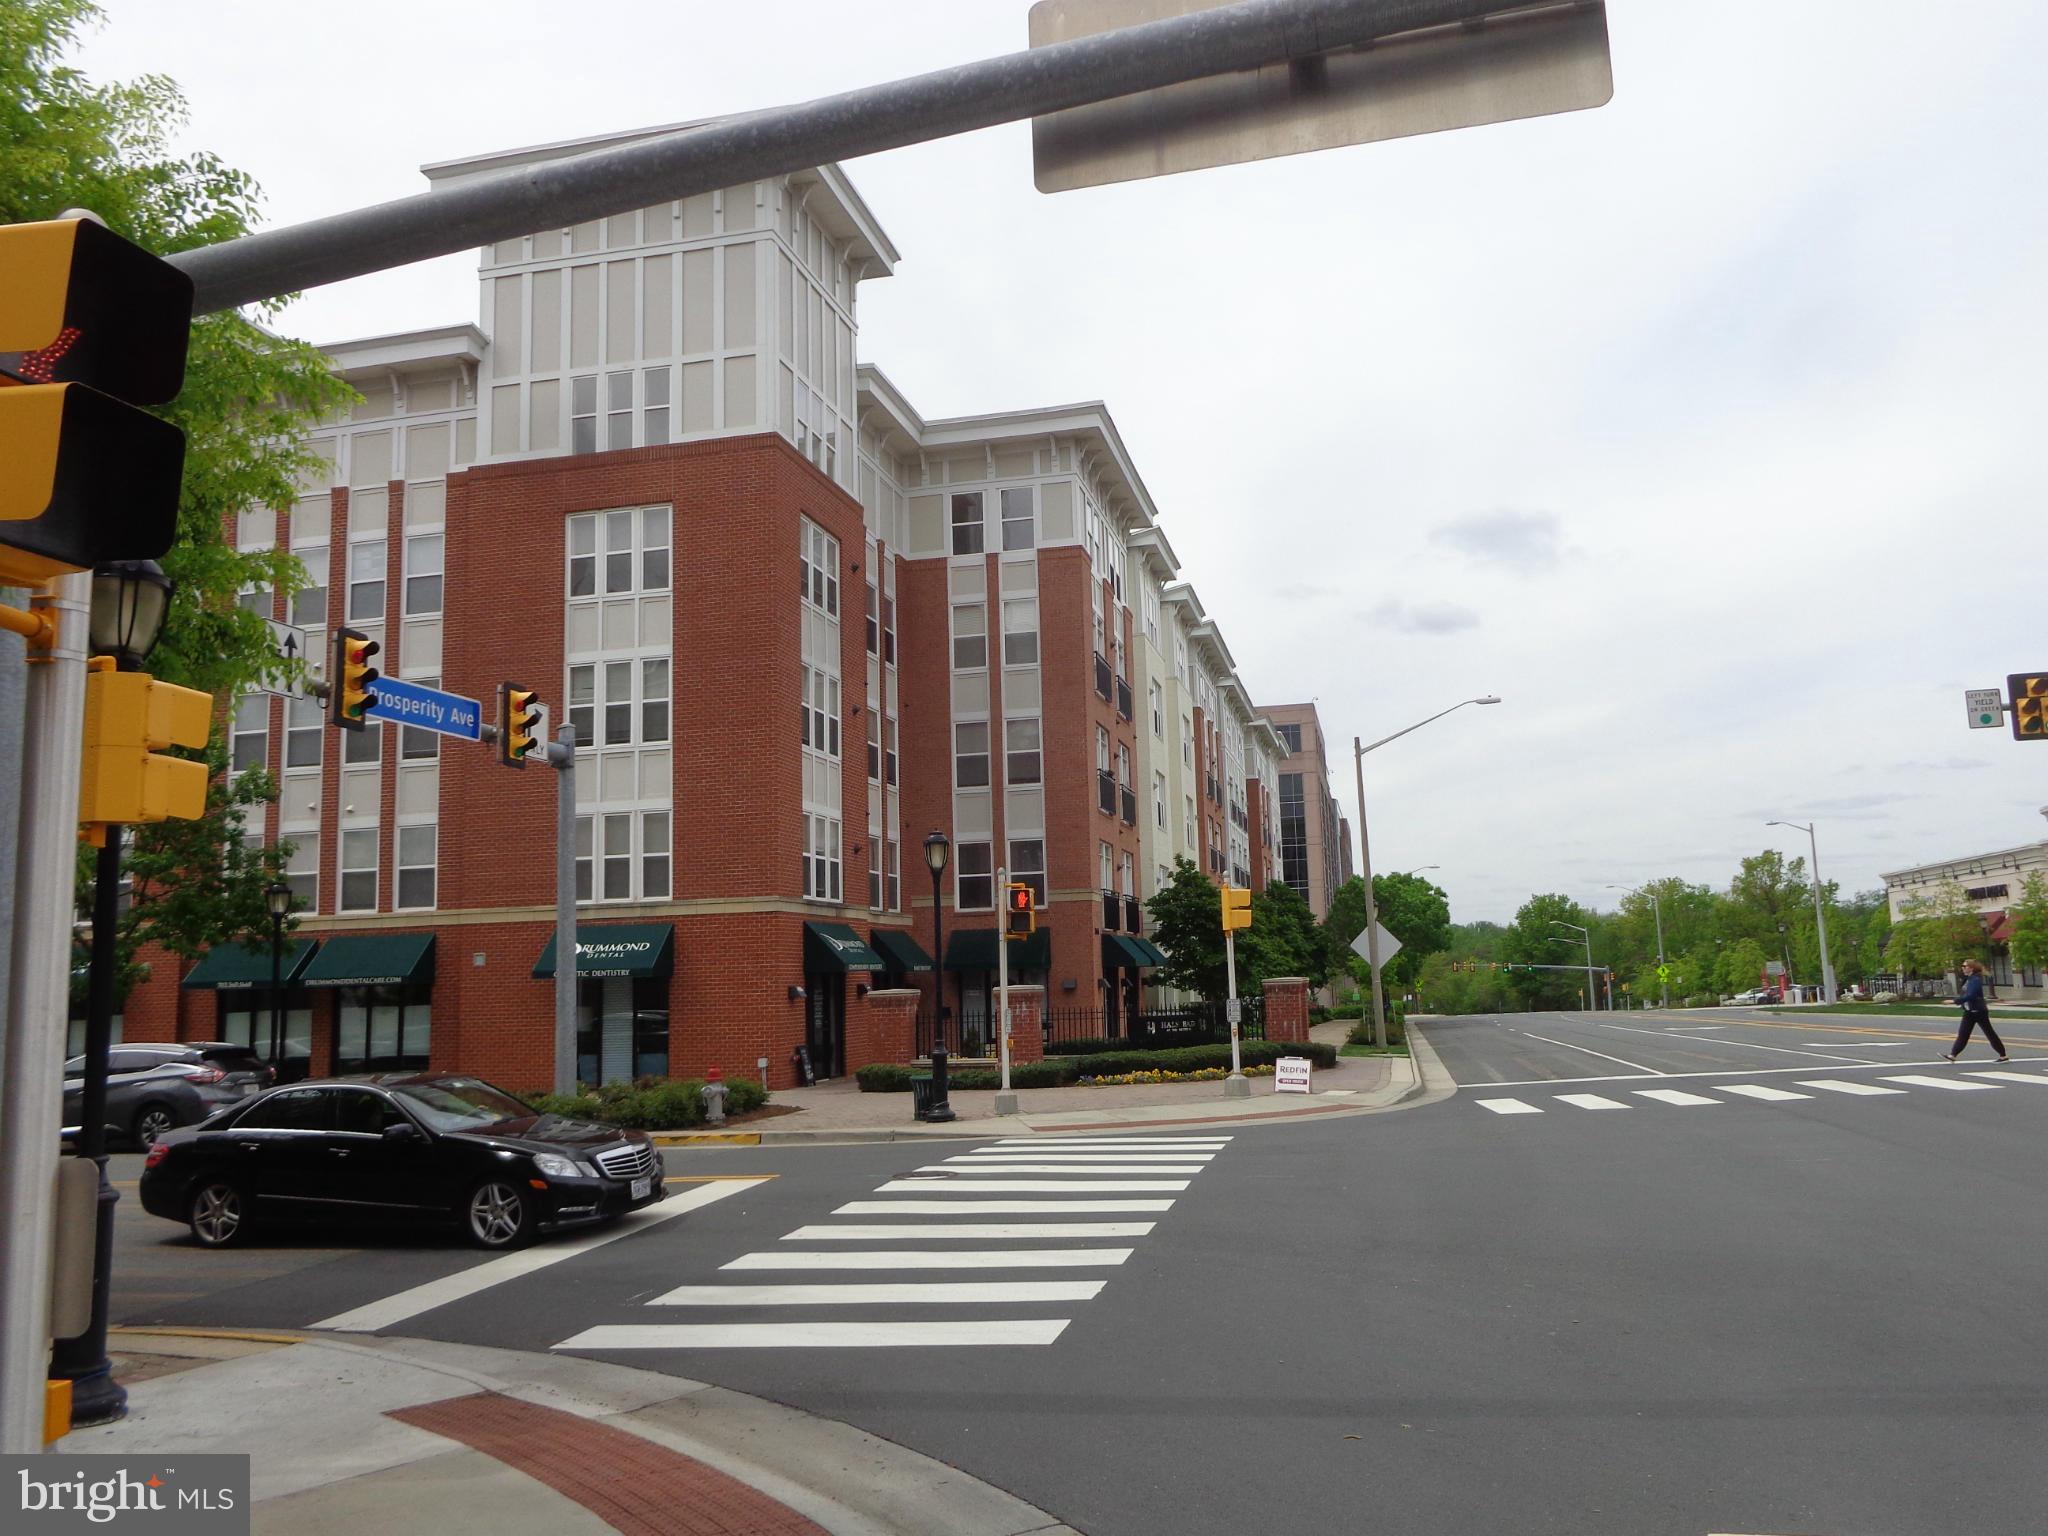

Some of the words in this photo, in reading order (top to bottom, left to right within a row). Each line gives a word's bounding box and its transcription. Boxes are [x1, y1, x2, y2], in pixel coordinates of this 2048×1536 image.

[368, 686, 445, 723] Prosperity
[450, 707, 474, 727] Ave
[592, 969, 630, 977] DENTISTRY
